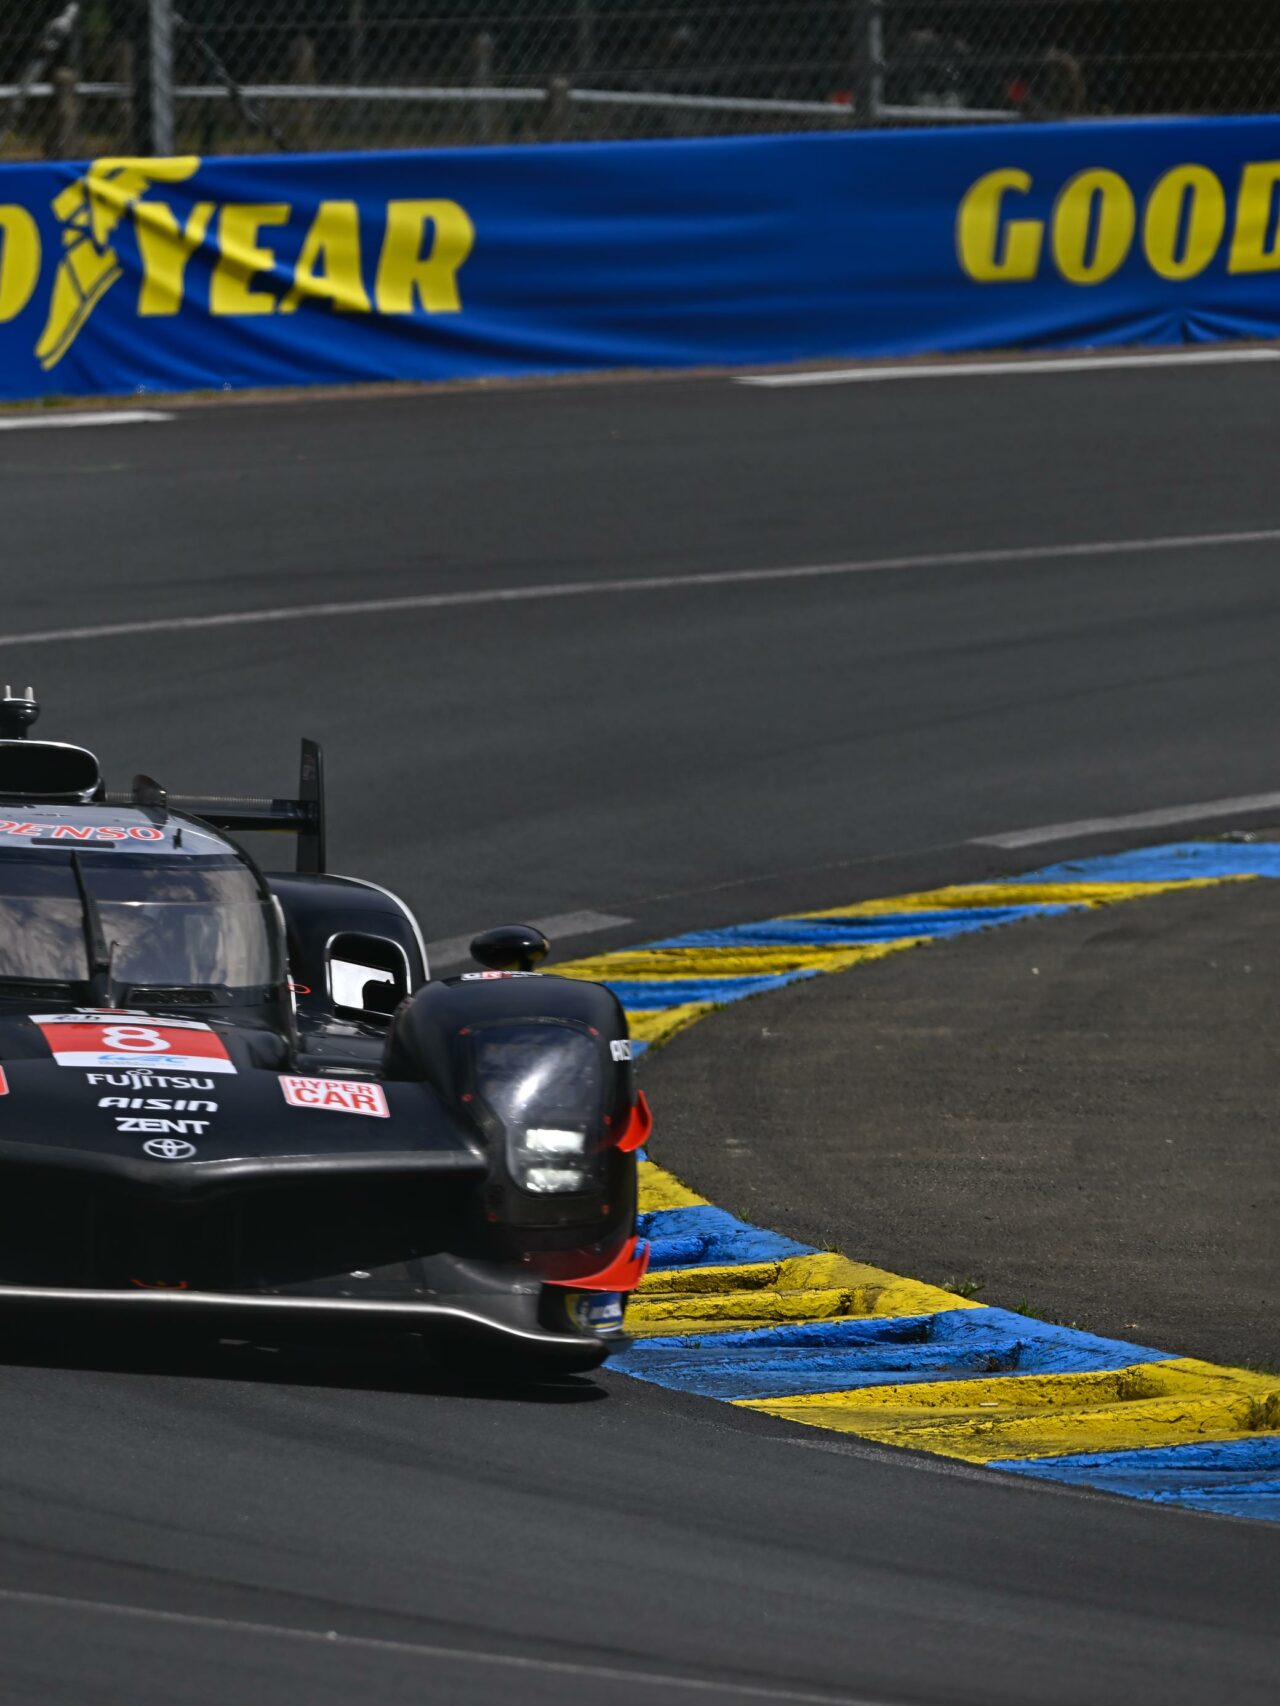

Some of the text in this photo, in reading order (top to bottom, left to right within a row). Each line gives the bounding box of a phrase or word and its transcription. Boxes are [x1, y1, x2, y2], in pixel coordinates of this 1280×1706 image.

[101, 1026, 171, 1052] 8
[86, 1070, 216, 1090] FUJITSU
[290, 1079, 373, 1095] HYPER
[97, 1097, 219, 1113] AISIN
[295, 1088, 378, 1112] CAR
[114, 1116, 211, 1135] ZENT
